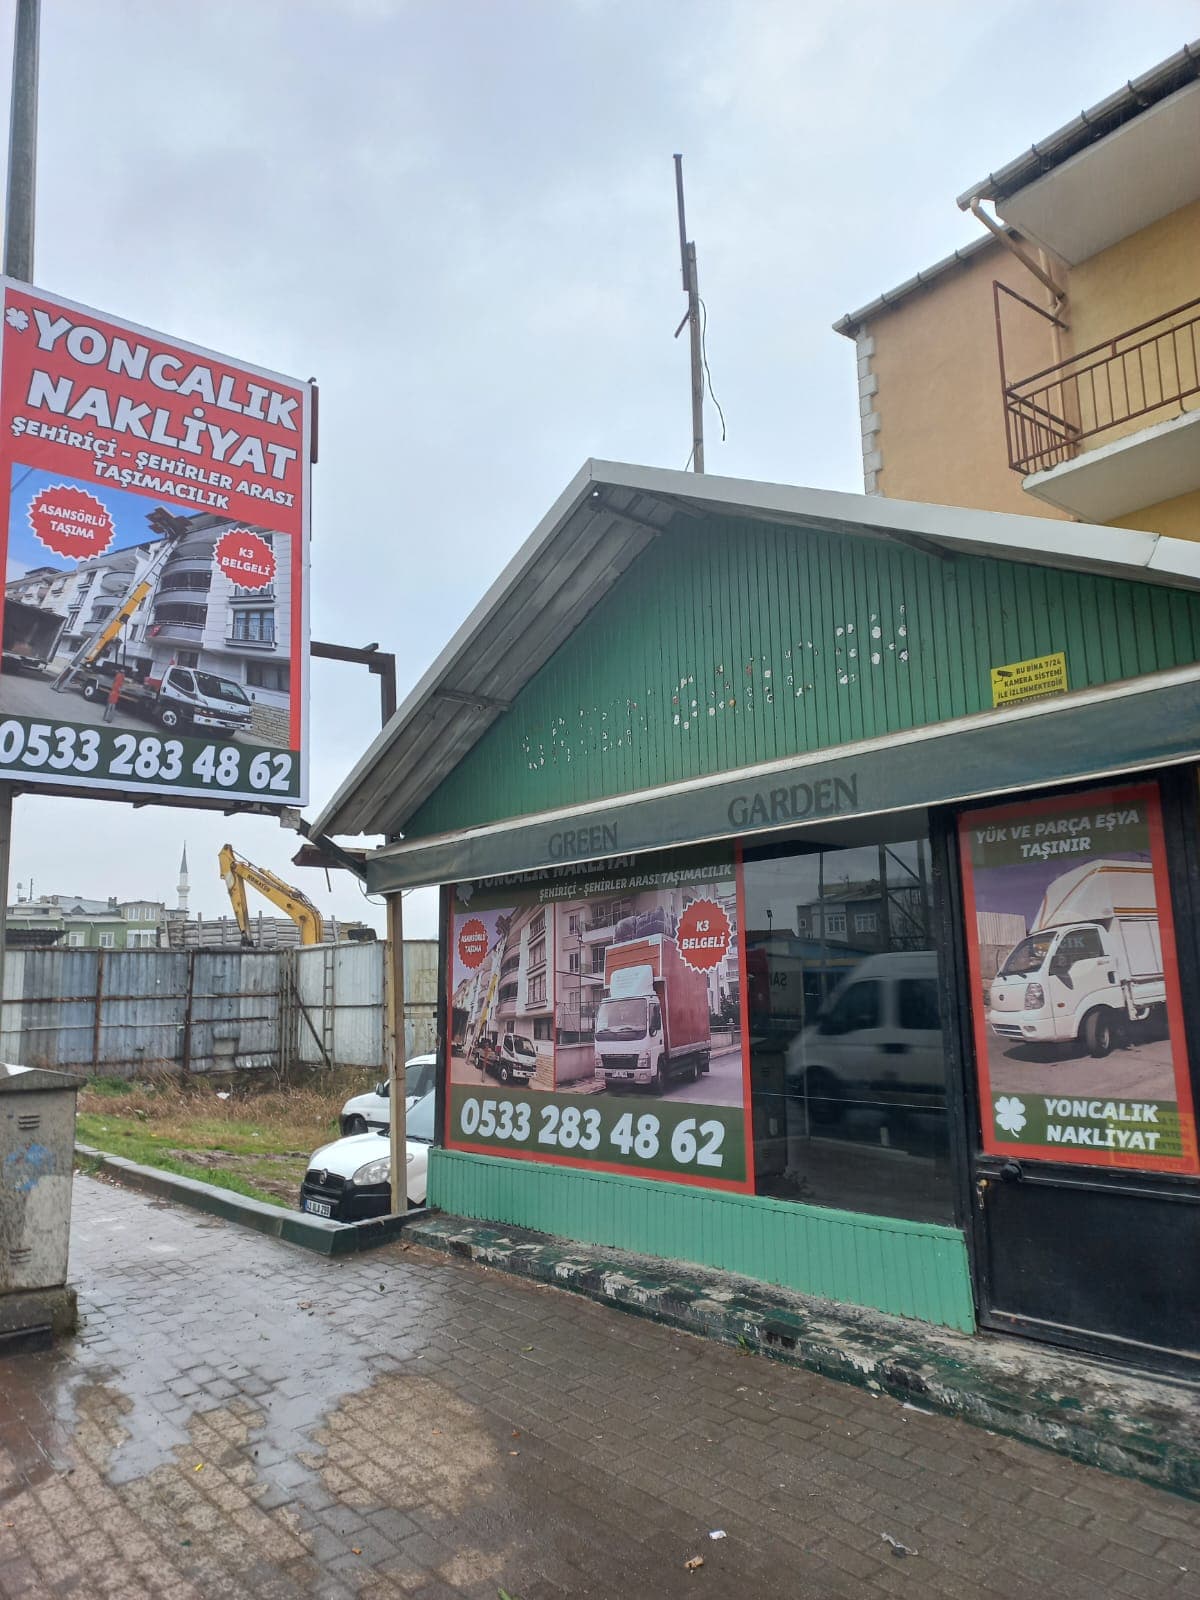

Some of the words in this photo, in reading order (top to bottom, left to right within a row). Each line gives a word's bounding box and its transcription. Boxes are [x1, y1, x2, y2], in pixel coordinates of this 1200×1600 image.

[33, 309, 299, 431] YONCALIK
[27, 369, 297, 480] NAKLİYAT
[11, 416, 117, 459] ŞEHİRİÇİ
[135, 451, 234, 491] ŞEHİRLER
[236, 483, 294, 507] ARASI
[93, 461, 229, 510] TAŞIMACILIK
[39, 502, 106, 528] ASANSÖRLÜ
[50, 521, 95, 540] TAŞIMA
[221, 556, 271, 576] BELGELİ
[239, 547, 254, 559] K3
[1004, 675, 1033, 688] KAMERA
[0, 720, 100, 772] 0533
[109, 734, 184, 780] 283
[192, 745, 240, 786] 48
[249, 751, 292, 791] 62
[727, 773, 858, 827] GARDEN
[547, 820, 619, 858] GREEN
[976, 825, 1007, 844] YÜK
[1011, 825, 1032, 840] VE
[1035, 816, 1091, 836] PARÇA
[1095, 809, 1140, 832] EŞYA
[1020, 836, 1091, 860] TAŞINIR
[539, 881, 577, 902] ŞEHİRİÇİ
[583, 878, 627, 897] ŞEHİRLER
[629, 873, 660, 888] ARASI
[661, 864, 732, 886] TAŞIMACILIK
[682, 932, 726, 950] BELGELİ
[696, 920, 709, 932] K3
[1044, 1098, 1159, 1123] YONCALIK
[460, 1097, 531, 1142] 0533
[538, 1104, 601, 1150] 283
[610, 1112, 660, 1159] 48
[671, 1118, 725, 1168] 62
[1046, 1124, 1160, 1150] NAKLİYAT
